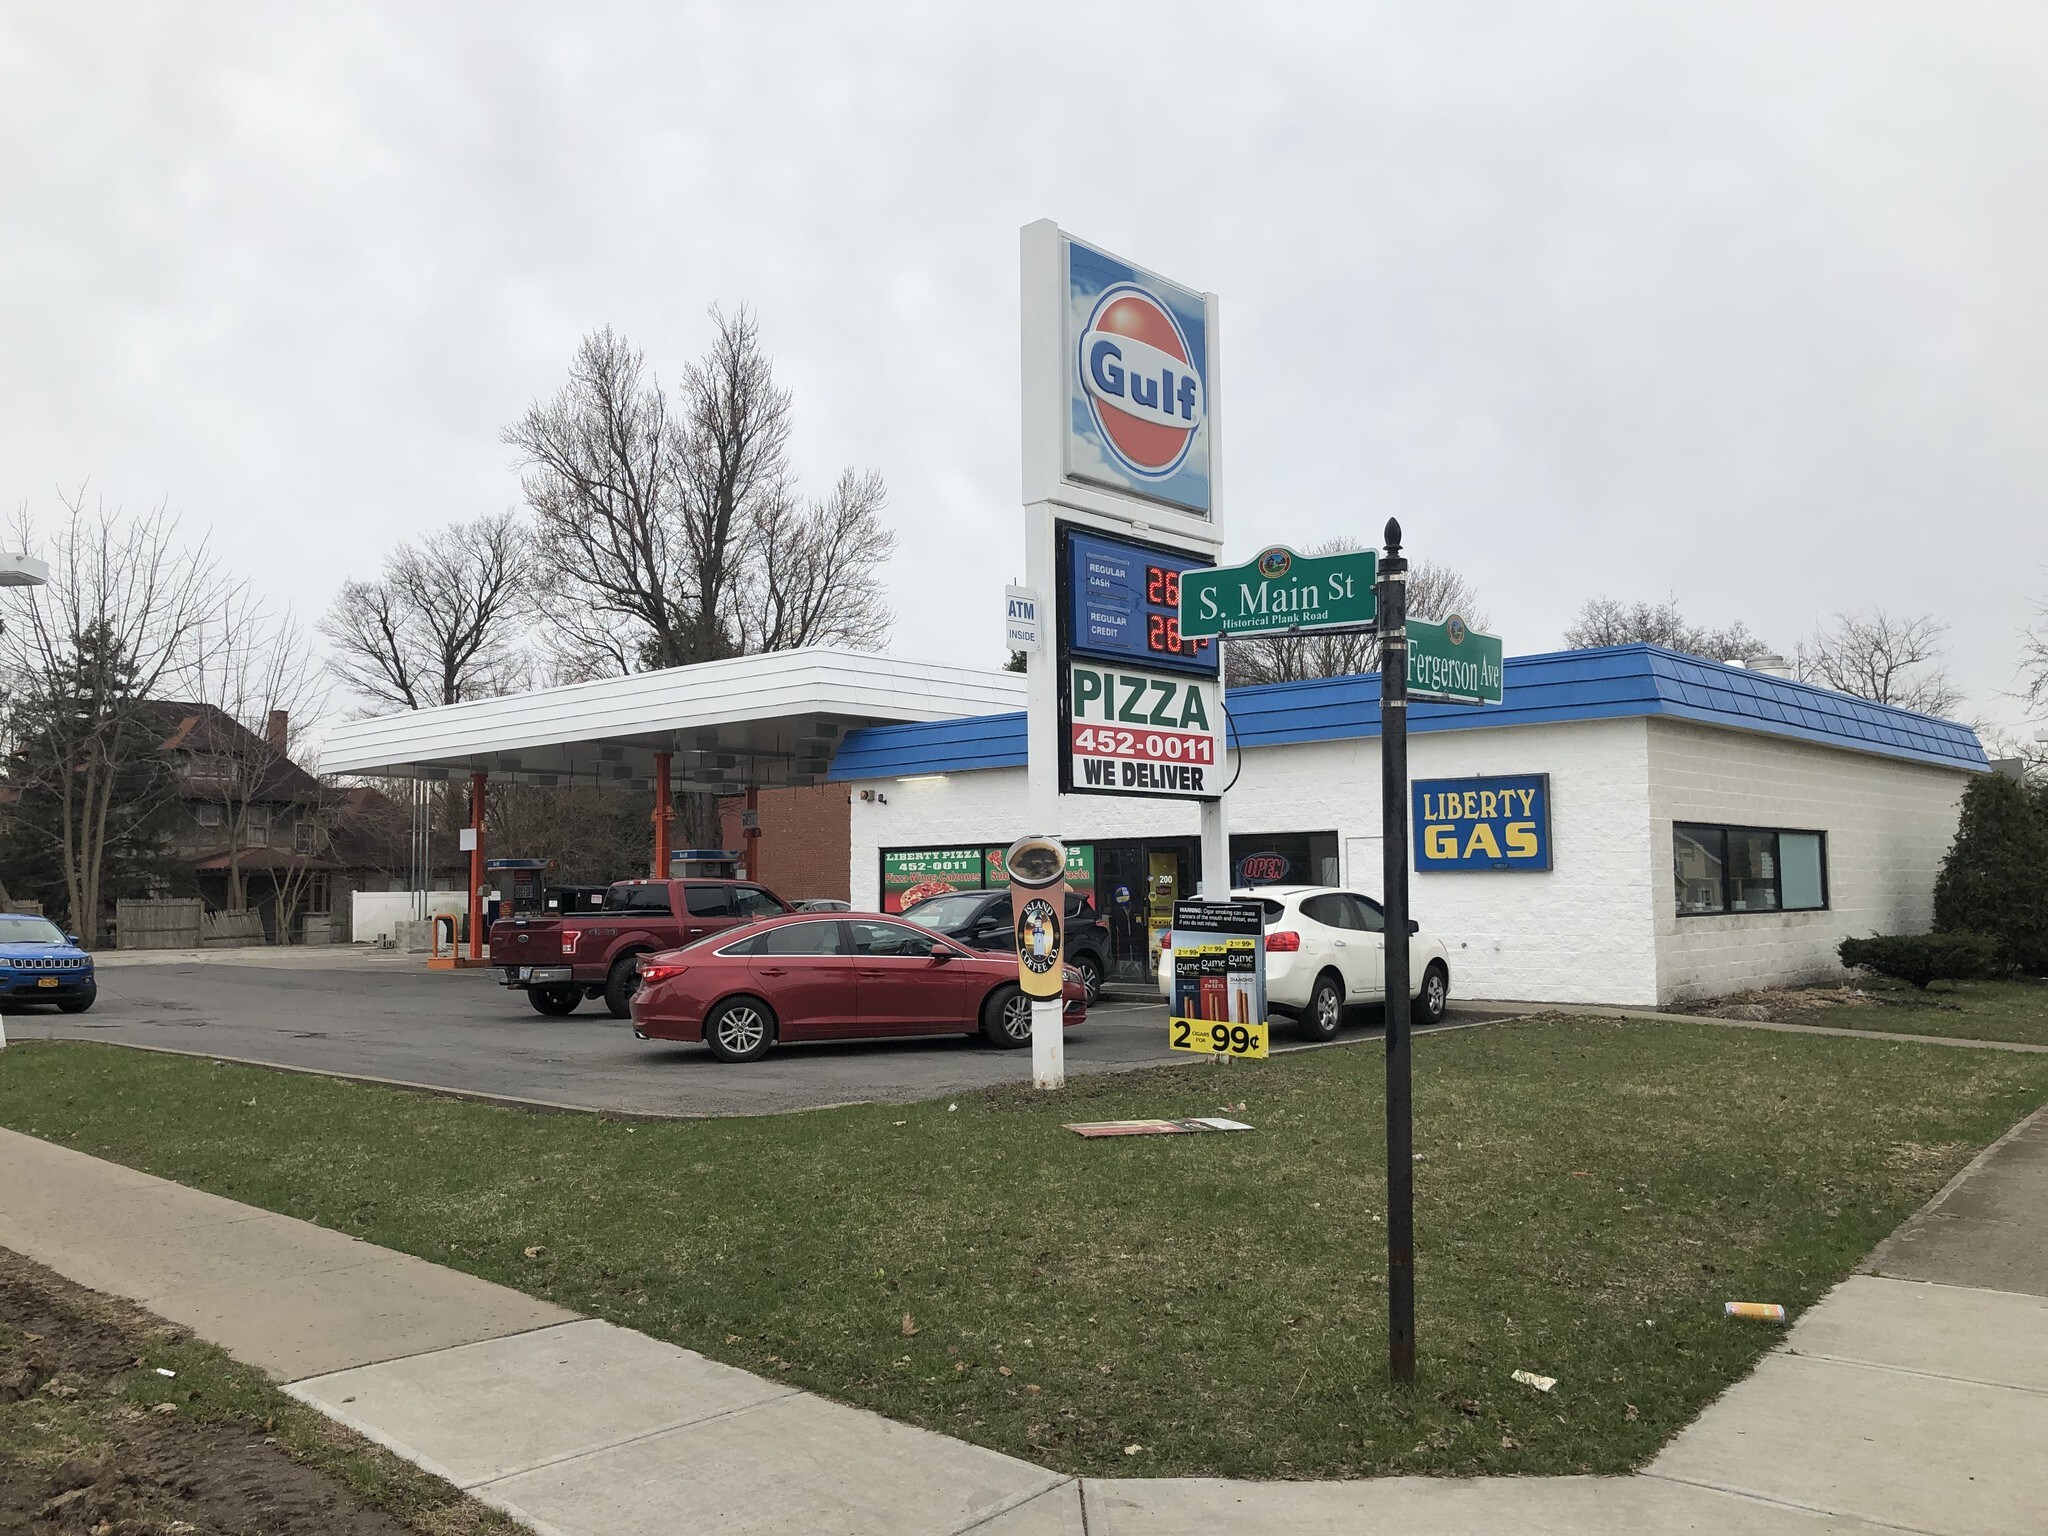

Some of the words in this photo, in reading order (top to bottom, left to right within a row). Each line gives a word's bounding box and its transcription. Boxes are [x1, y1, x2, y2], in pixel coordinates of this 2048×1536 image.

[1090, 340, 1196, 420] Gulf
[1090, 563, 1126, 579] REGULAR
[1090, 576, 1110, 588] CASH
[1149, 567, 1179, 606] 26
[1199, 586, 1226, 620] S.
[1238, 576, 1320, 617] Main
[1328, 572, 1355, 601] St
[1008, 600, 1034, 620] ATM
[1090, 612, 1127, 626] REGULAR
[1223, 616, 1269, 629] Historical
[1271, 613, 1300, 625] Plank
[1303, 609, 1329, 621] Road
[1009, 629, 1035, 642] INSIDE
[1091, 625, 1118, 638] CREDIT
[1406, 638, 1478, 691] Fergerson
[1480, 654, 1499, 688] Ave
[1074, 669, 1210, 731] PIZZA
[1075, 728, 1210, 761] 452-0011
[1083, 758, 1116, 786] WE
[1122, 761, 1204, 791] DELIVER
[1423, 788, 1536, 821] LIBERTY
[1424, 821, 1538, 859] GAS
[886, 852, 940, 861] LIBERTY
[942, 850, 981, 859] PIZZA
[899, 861, 967, 871] 452-0011
[1064, 869, 1089, 880] asta
[1244, 858, 1284, 879] OPEN
[885, 872, 908, 883] Pizza
[910, 871, 937, 883] Wings
[939, 871, 981, 882] Calzones
[1159, 875, 1173, 884] 200
[1024, 900, 1054, 916] ISLAND
[1020, 948, 1048, 973] COFFEE
[1047, 948, 1059, 965] CO.
[1176, 962, 1200, 976] game
[1201, 959, 1226, 972] game
[1228, 954, 1253, 968] game
[1173, 1020, 1191, 1048] 2
[1192, 1030, 1209, 1038] CIGARS
[1211, 1024, 1259, 1054] 99¢
